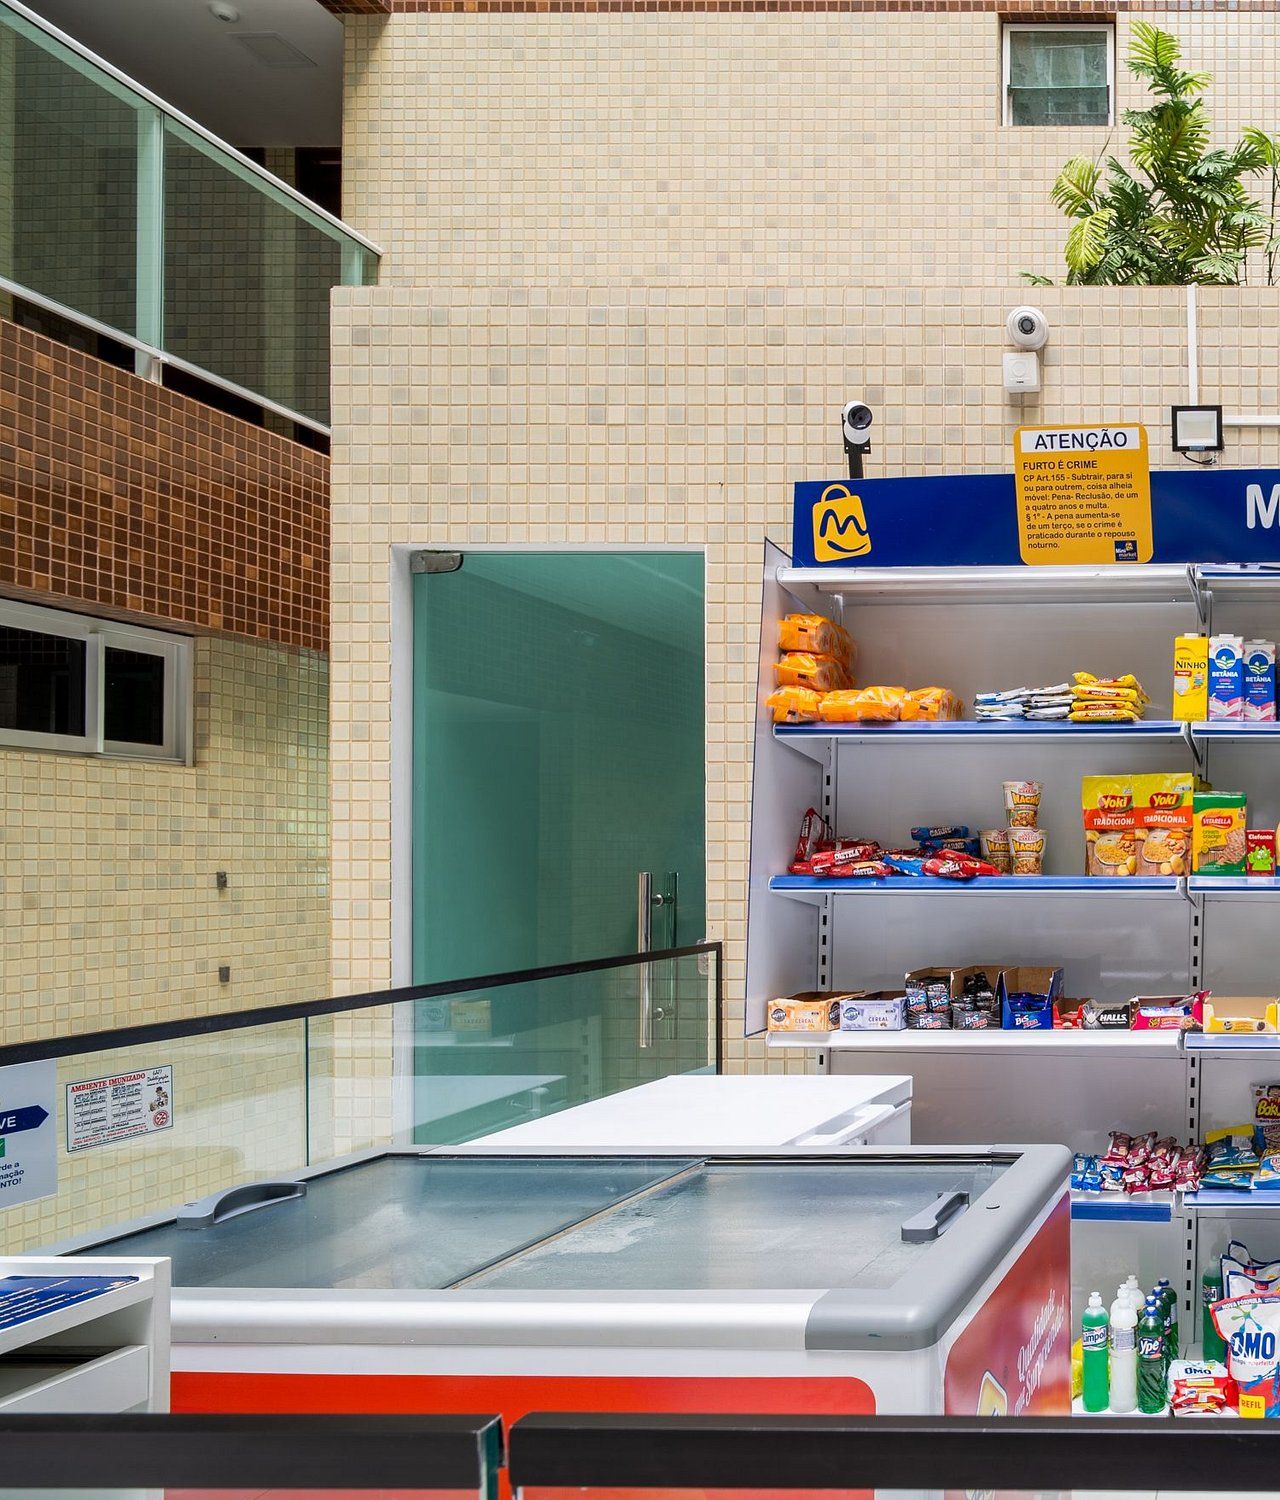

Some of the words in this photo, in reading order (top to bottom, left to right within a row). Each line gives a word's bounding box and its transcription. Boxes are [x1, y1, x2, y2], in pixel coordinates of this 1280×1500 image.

[1035, 428, 1127, 452] ATENÇÃO
[1023, 462, 1056, 470] FURTO
[1058, 460, 1064, 469] É
[1066, 460, 1098, 469] CRIME
[1071, 473, 1104, 481] Subtrair,
[1035, 484, 1053, 493] para
[1055, 483, 1084, 492] outrem,
[1076, 492, 1112, 500] Reclusão,
[1176, 661, 1206, 669] NINHO
[1102, 797, 1128, 809] Yoki
[1153, 795, 1177, 806] Yoki
[988, 842, 1010, 853] NACH
[71, 1080, 107, 1093] AMBIENTE
[109, 1073, 146, 1086] IMUNIZADO
[1231, 1332, 1276, 1360] OMO
[1242, 1400, 1261, 1408] REFIL
